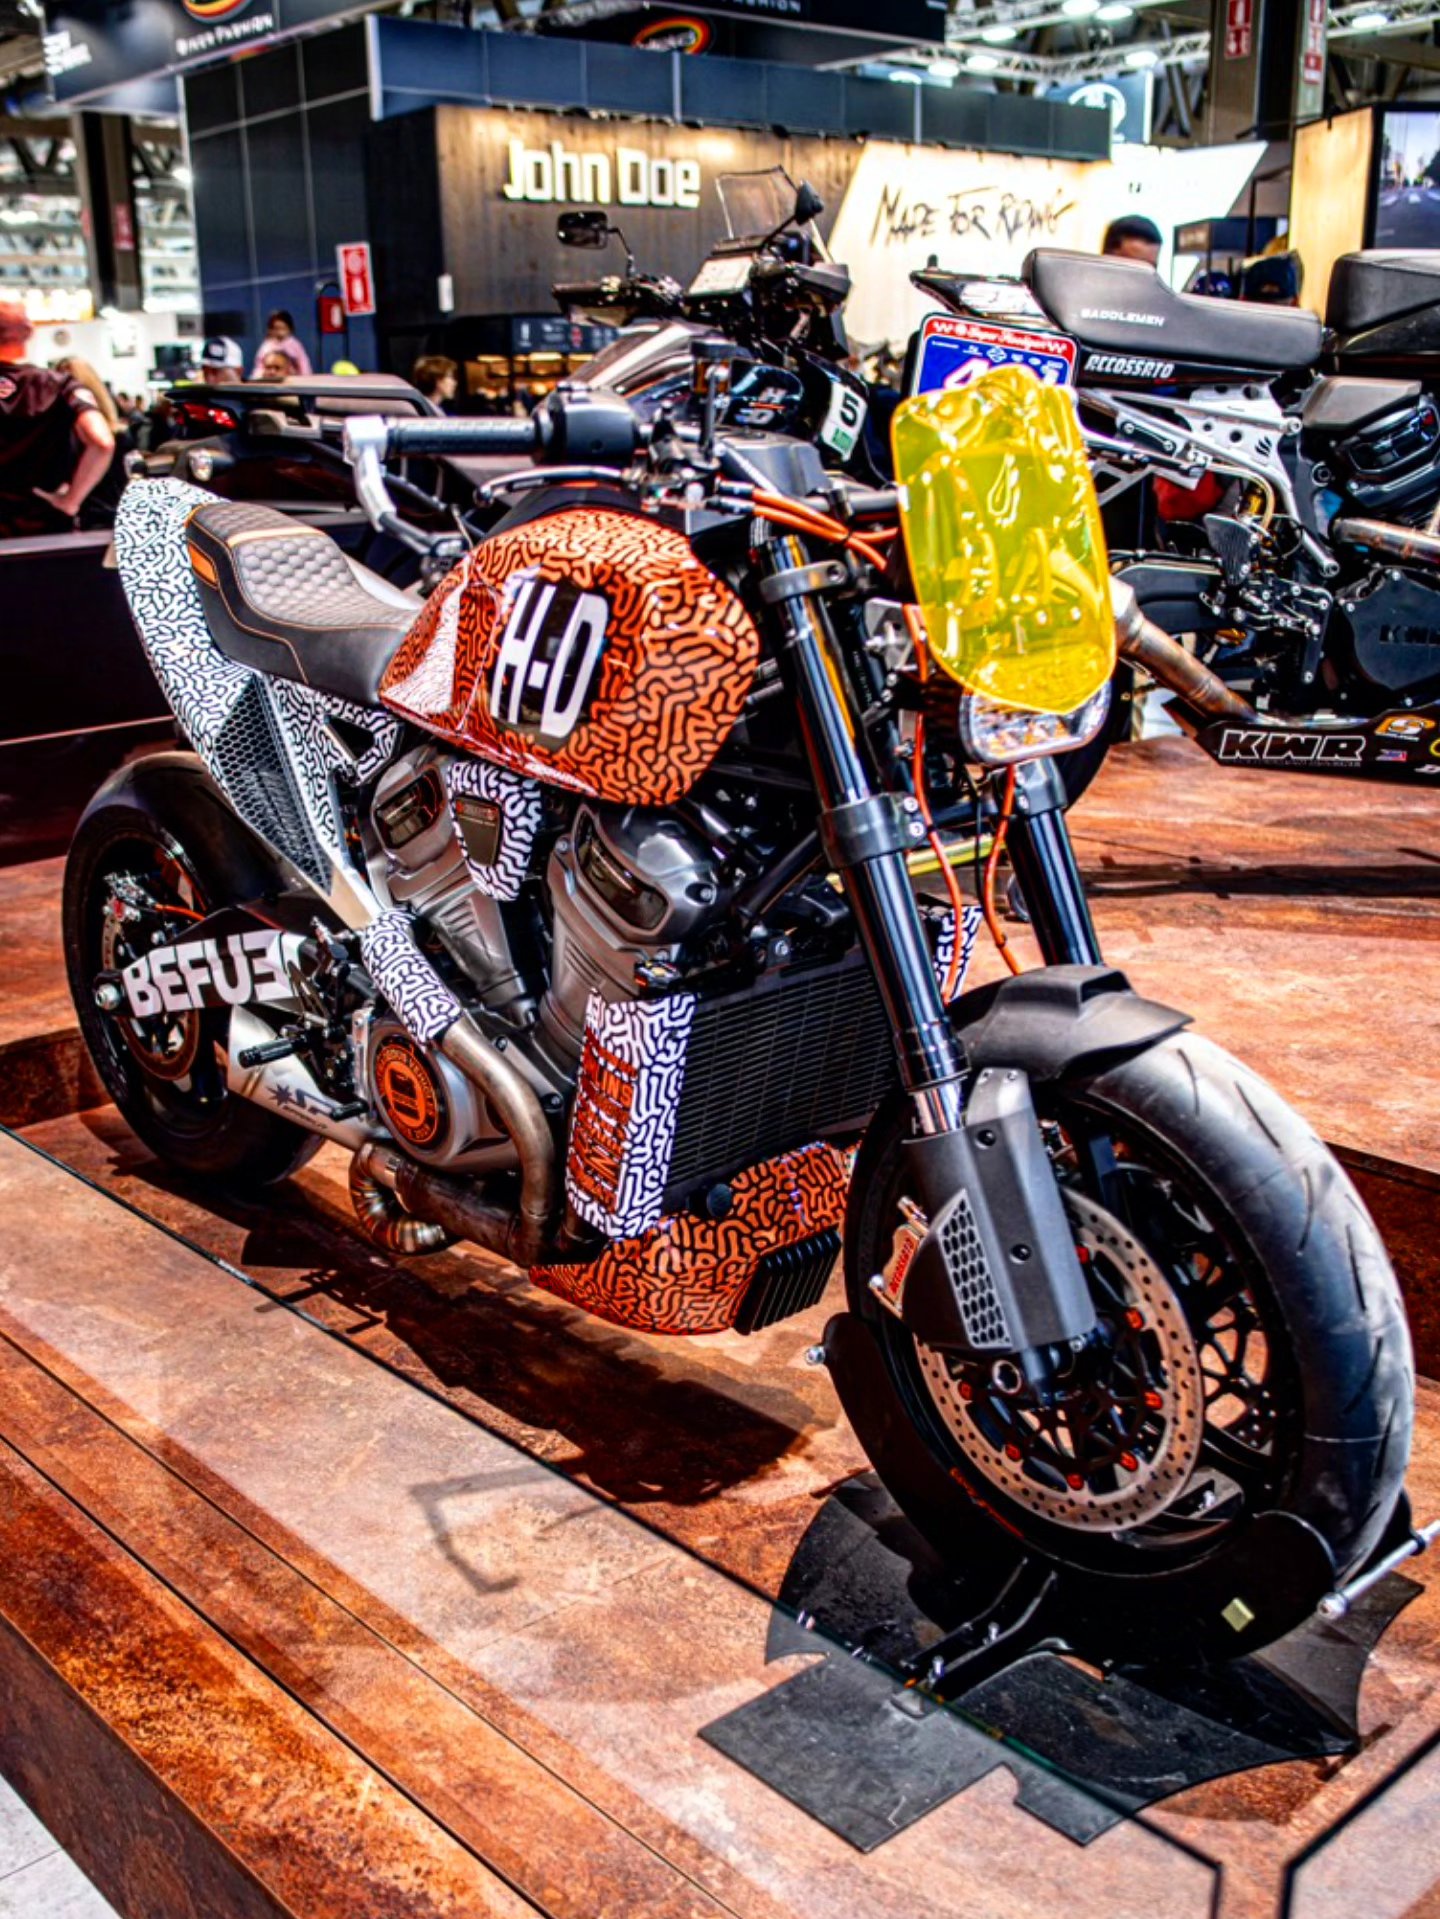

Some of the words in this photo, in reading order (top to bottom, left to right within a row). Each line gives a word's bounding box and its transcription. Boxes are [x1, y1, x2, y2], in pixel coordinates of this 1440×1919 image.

[503, 138, 610, 204] John
[617, 147, 700, 209] Doe
[1080, 308, 1165, 327] SADDLEMEN
[490, 580, 608, 738] H-D
[1218, 728, 1366, 761] KWR
